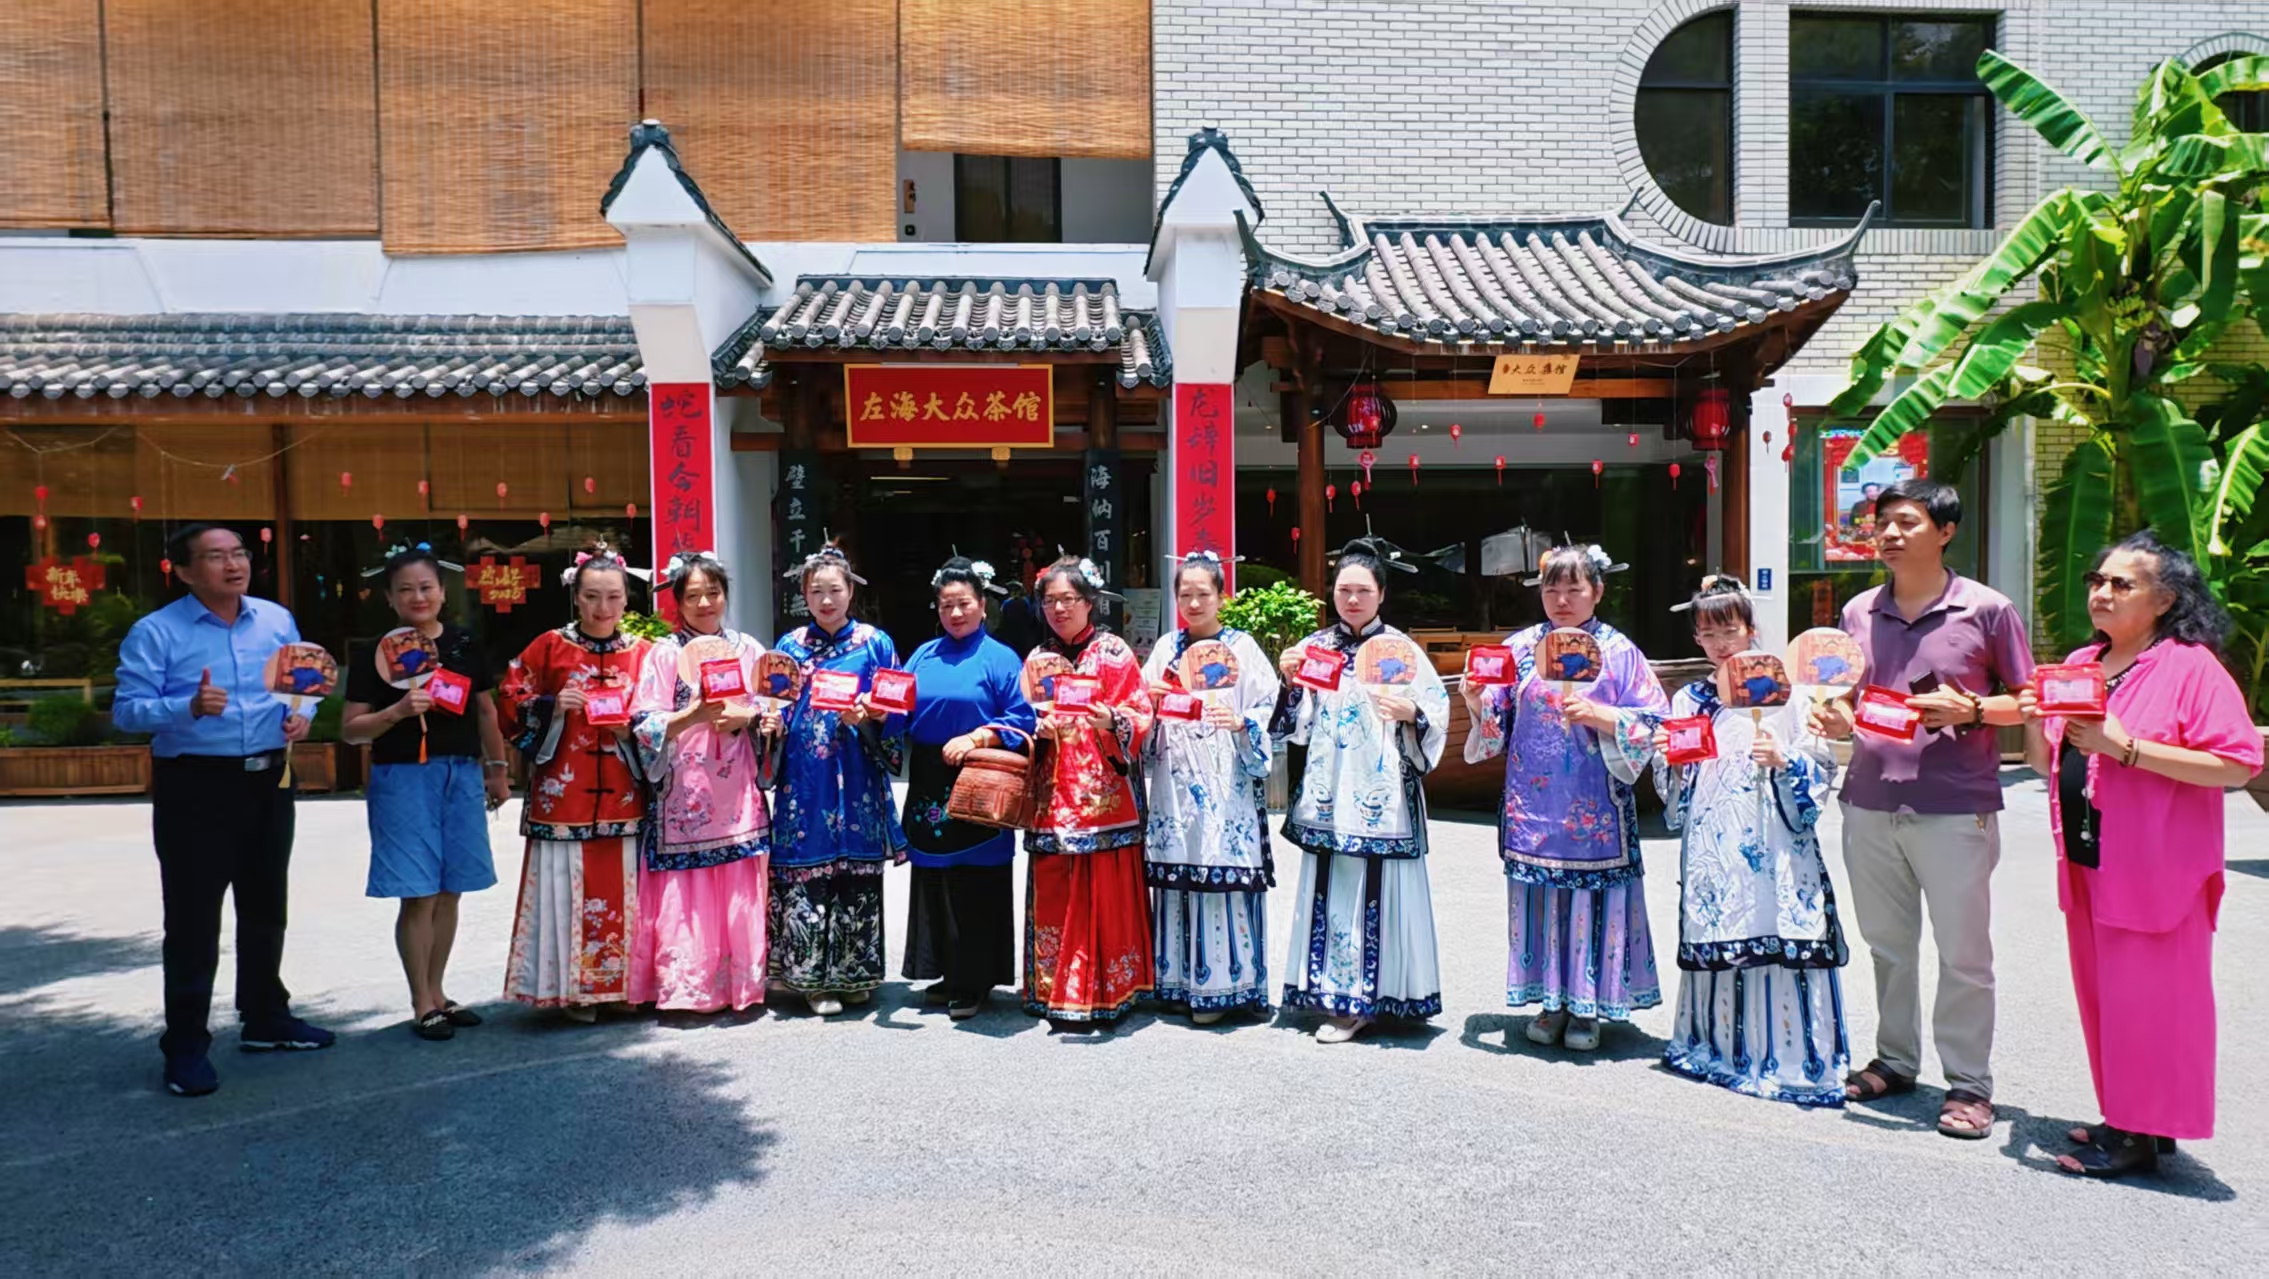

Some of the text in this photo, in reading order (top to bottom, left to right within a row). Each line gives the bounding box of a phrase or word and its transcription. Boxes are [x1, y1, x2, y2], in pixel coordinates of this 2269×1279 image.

[859, 390, 1042, 422] 左海大众茶馆
